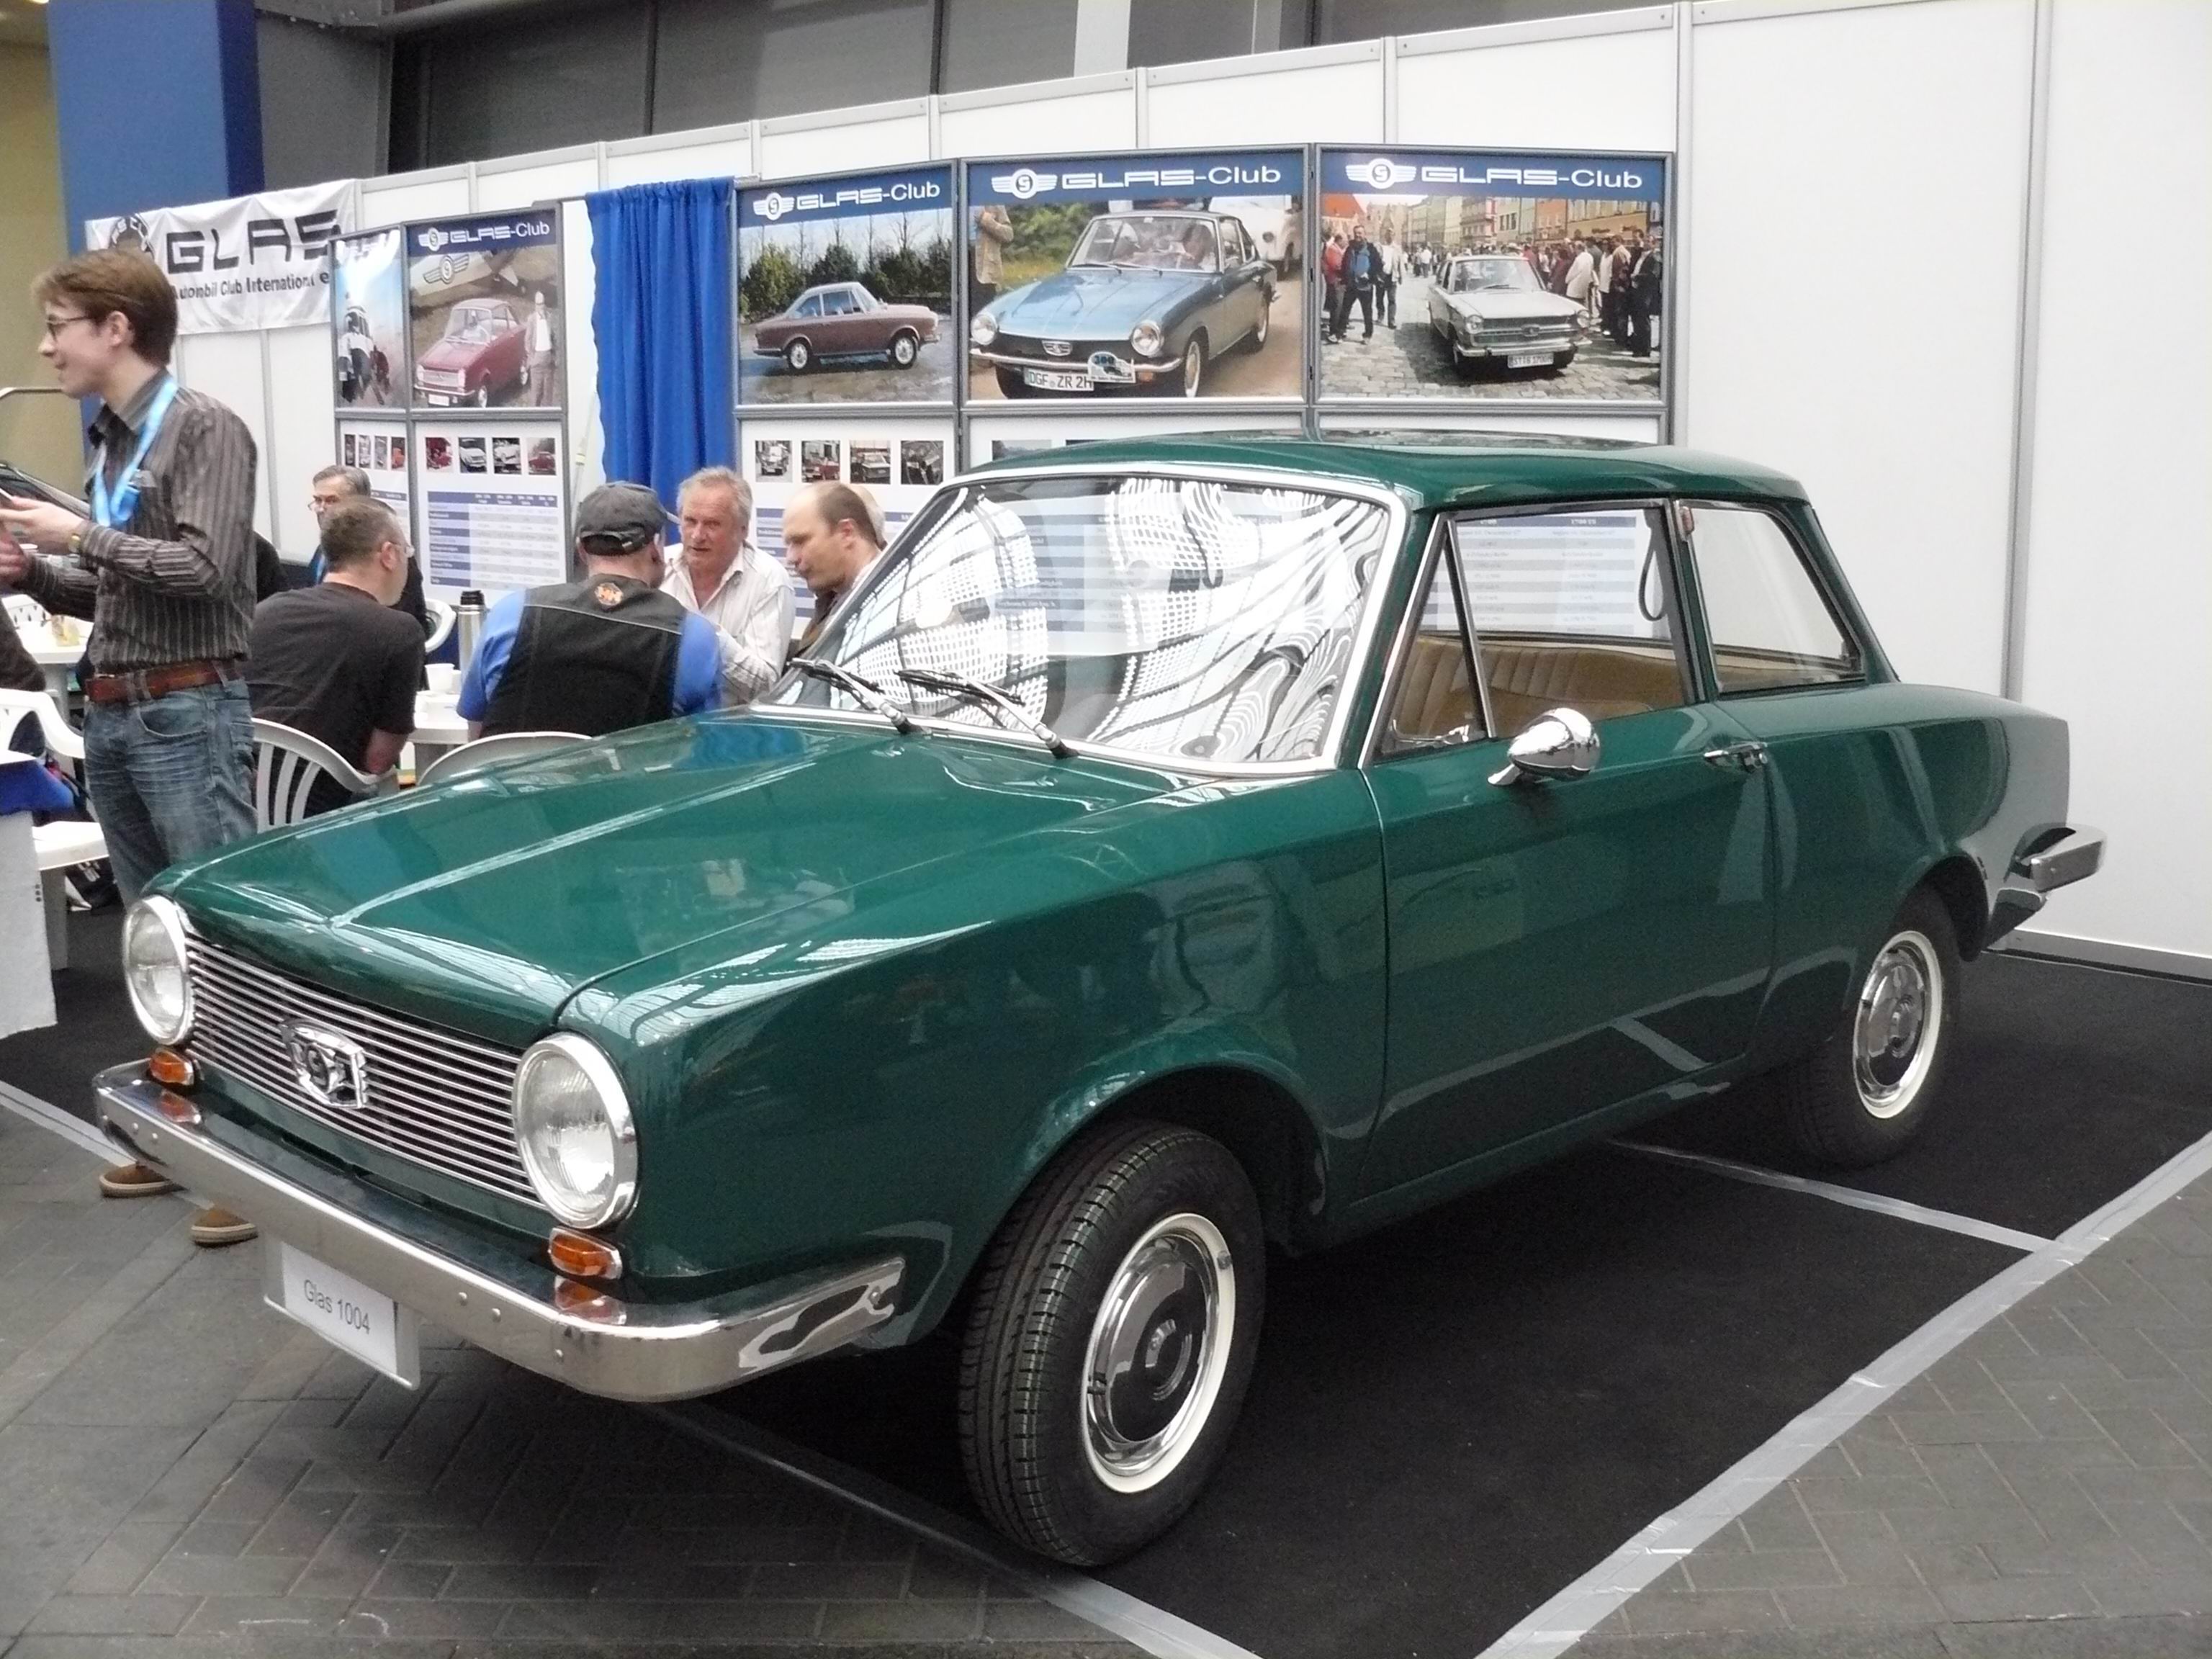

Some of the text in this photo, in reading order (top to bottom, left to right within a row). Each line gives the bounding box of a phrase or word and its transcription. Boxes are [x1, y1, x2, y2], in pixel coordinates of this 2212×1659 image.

[1062, 166, 1281, 189] GLAS-Club
[1421, 166, 1642, 189] GLAS-Club
[796, 181, 940, 210] GLAS-Club
[166, 209, 341, 274] GLAS
[450, 221, 550, 243] GLAS-Club
[220, 279, 242, 296] Club
[1057, 375, 1073, 388] ZR
[304, 1279, 370, 1334] Glas 1004
